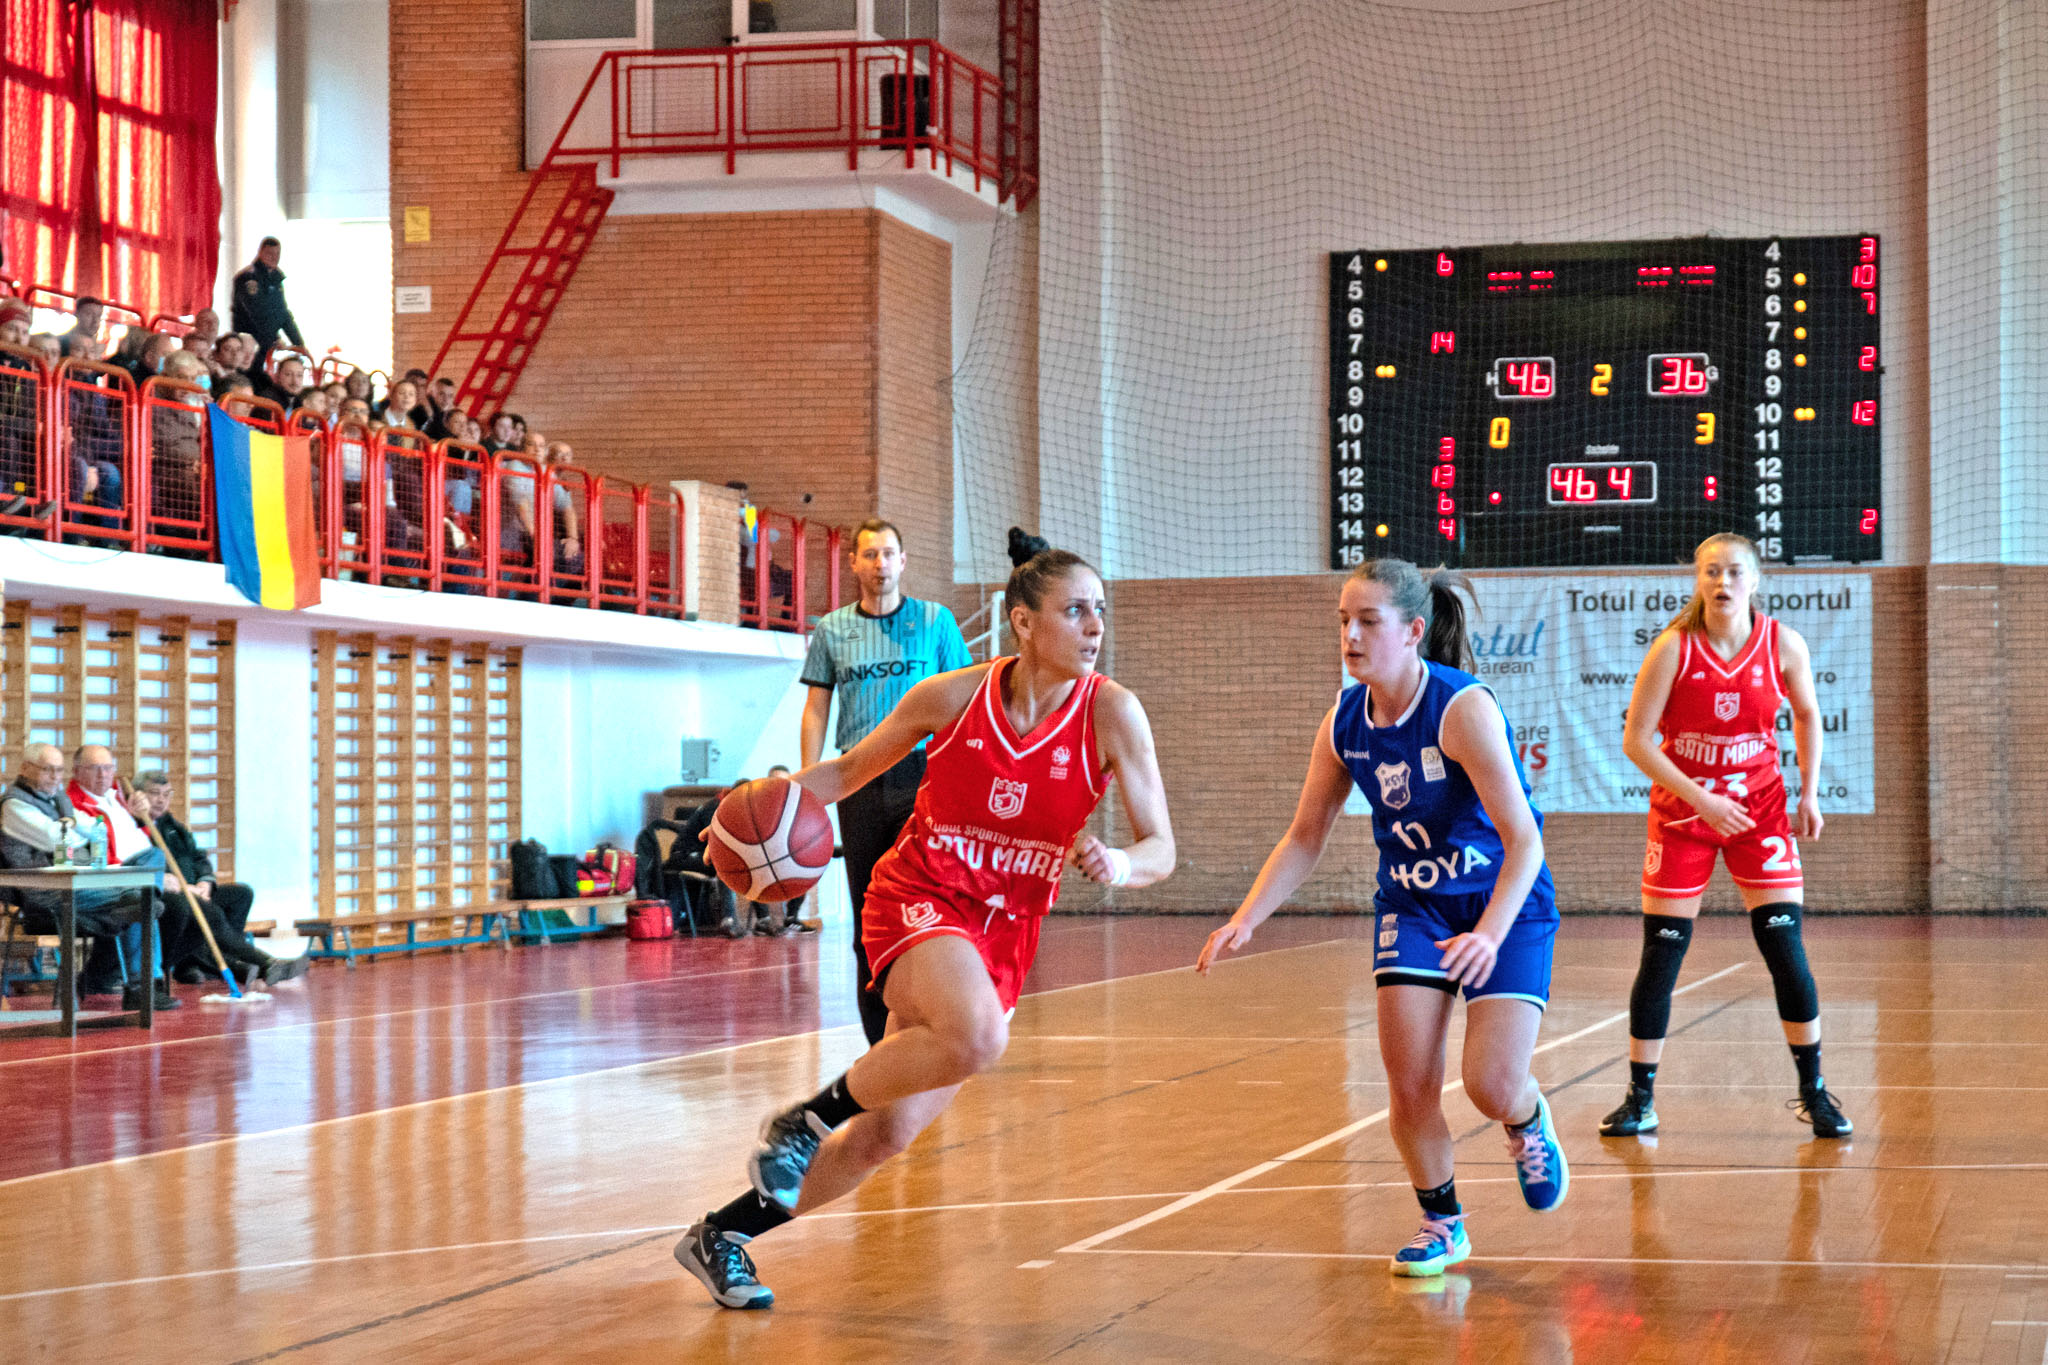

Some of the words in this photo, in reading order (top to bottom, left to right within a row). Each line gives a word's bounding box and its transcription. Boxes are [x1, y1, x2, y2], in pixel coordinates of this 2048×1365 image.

[1765, 242, 1781, 261] 4
[1348, 255, 1363, 274] 4
[1437, 253, 1454, 276] 6
[1765, 268, 1781, 288] 5
[1852, 264, 1876, 289] 10
[1348, 281, 1363, 300] 5
[1765, 295, 1781, 315] 6
[1861, 292, 1876, 314] 7
[1348, 308, 1363, 328] 6
[1431, 331, 1455, 353] 14
[1765, 322, 1781, 341] 7
[1348, 334, 1363, 353] 7
[1765, 349, 1781, 370] 8
[1859, 346, 1876, 371] 2
[1348, 361, 1363, 381] 8
[1486, 371, 1498, 386] H
[1507, 362, 1551, 396] 46
[1591, 364, 1612, 395] 2
[1660, 358, 1705, 393] 36
[1705, 366, 1719, 381] G
[1765, 375, 1781, 396] 9
[1348, 386, 1363, 407] 9
[1337, 414, 1363, 434] 10
[1755, 403, 1782, 424] 10
[1489, 417, 1510, 448] 0
[1695, 413, 1715, 444] 3
[1337, 440, 1362, 460] 11
[1755, 430, 1780, 450] 11
[1337, 467, 1363, 487] 12
[1755, 457, 1782, 478] 12
[1551, 468, 1598, 502] 46
[1607, 467, 1632, 500] 4
[1755, 483, 1782, 504] 13
[1338, 493, 1364, 513] 13
[1438, 491, 1455, 514] 6
[1338, 519, 1364, 539] 14
[1438, 518, 1455, 540] 4
[1755, 511, 1782, 531] 14
[1860, 508, 1878, 534] 2
[1338, 546, 1364, 565] 15
[1756, 537, 1782, 559] 15
[1567, 589, 1634, 612] Totul
[1645, 589, 1692, 612] des
[1472, 620, 1545, 657] rtul
[1516, 725, 1549, 741] are
[1675, 738, 1718, 765] SATU
[991, 846, 1063, 882] MARE
[1389, 845, 1492, 889] HOYA
